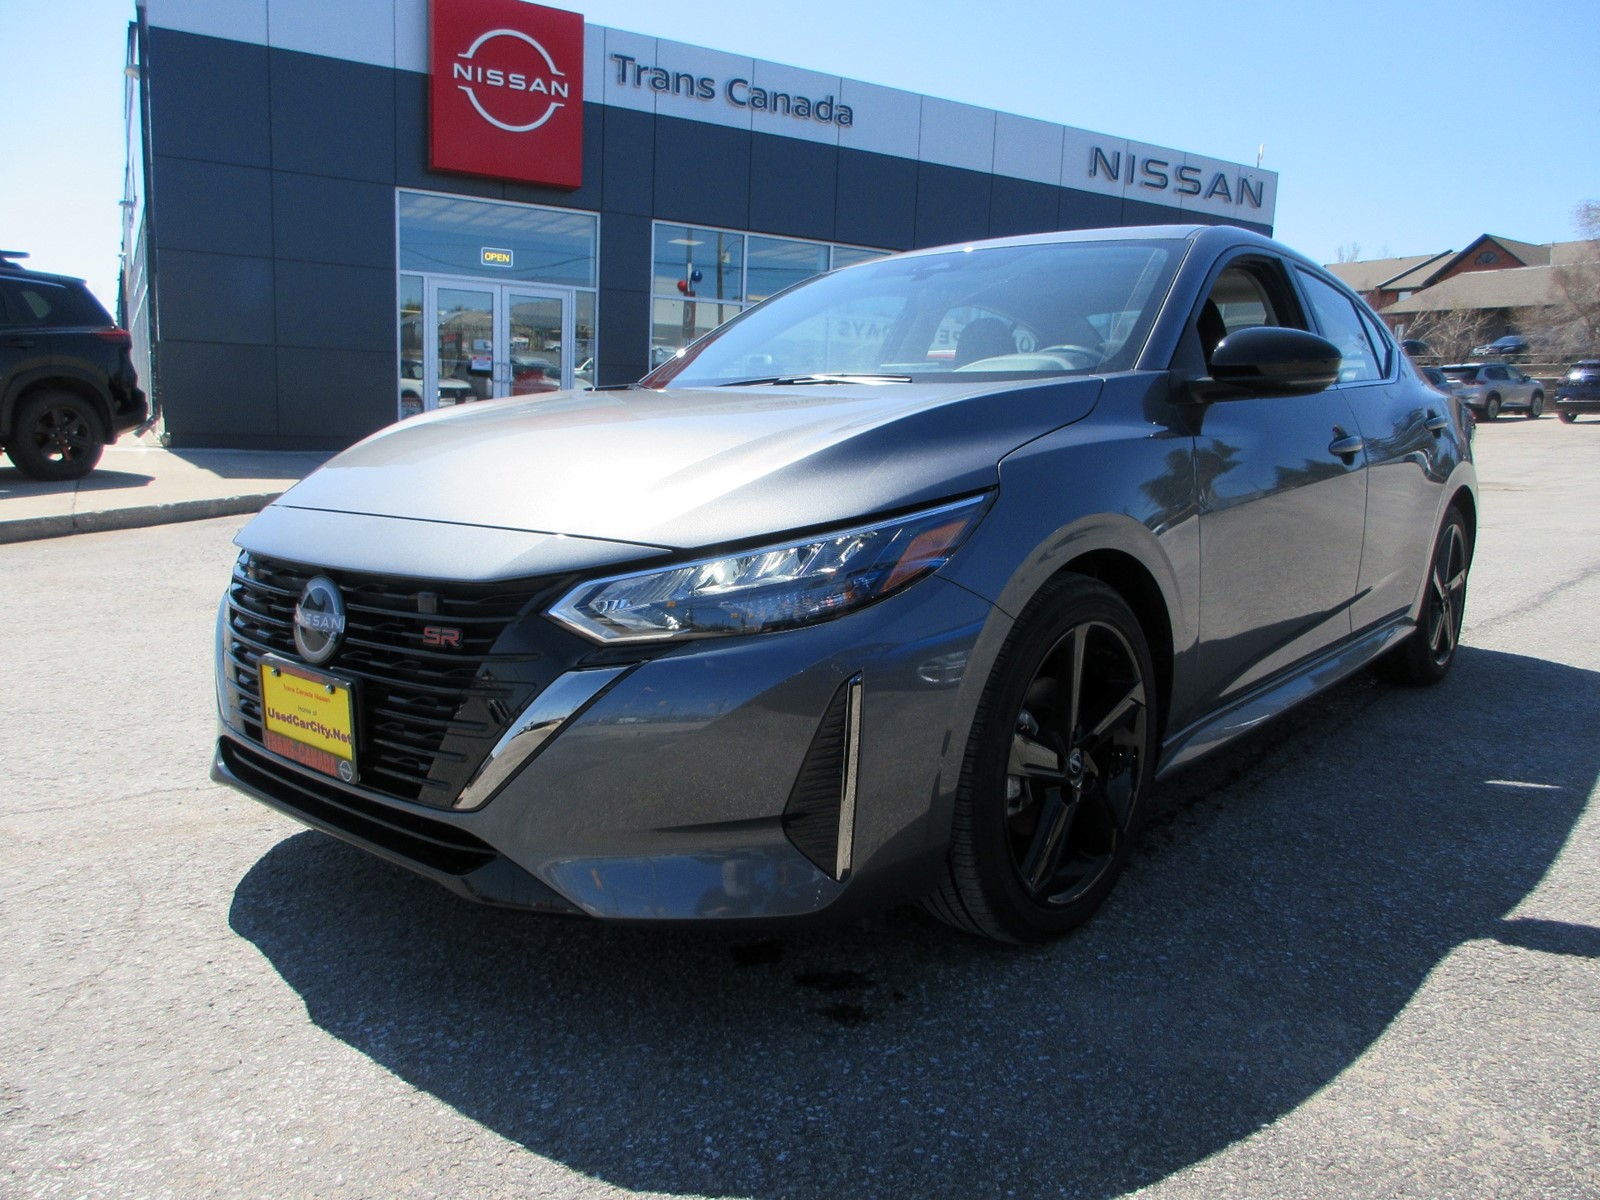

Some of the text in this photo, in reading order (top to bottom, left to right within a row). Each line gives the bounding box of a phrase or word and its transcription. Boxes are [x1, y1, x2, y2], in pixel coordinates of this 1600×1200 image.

[453, 62, 569, 98] NISSAN
[611, 54, 855, 126] Trans Canada
[1090, 147, 1264, 208] NISSAN
[484, 252, 510, 263] OPEN
[423, 626, 461, 647] SR
